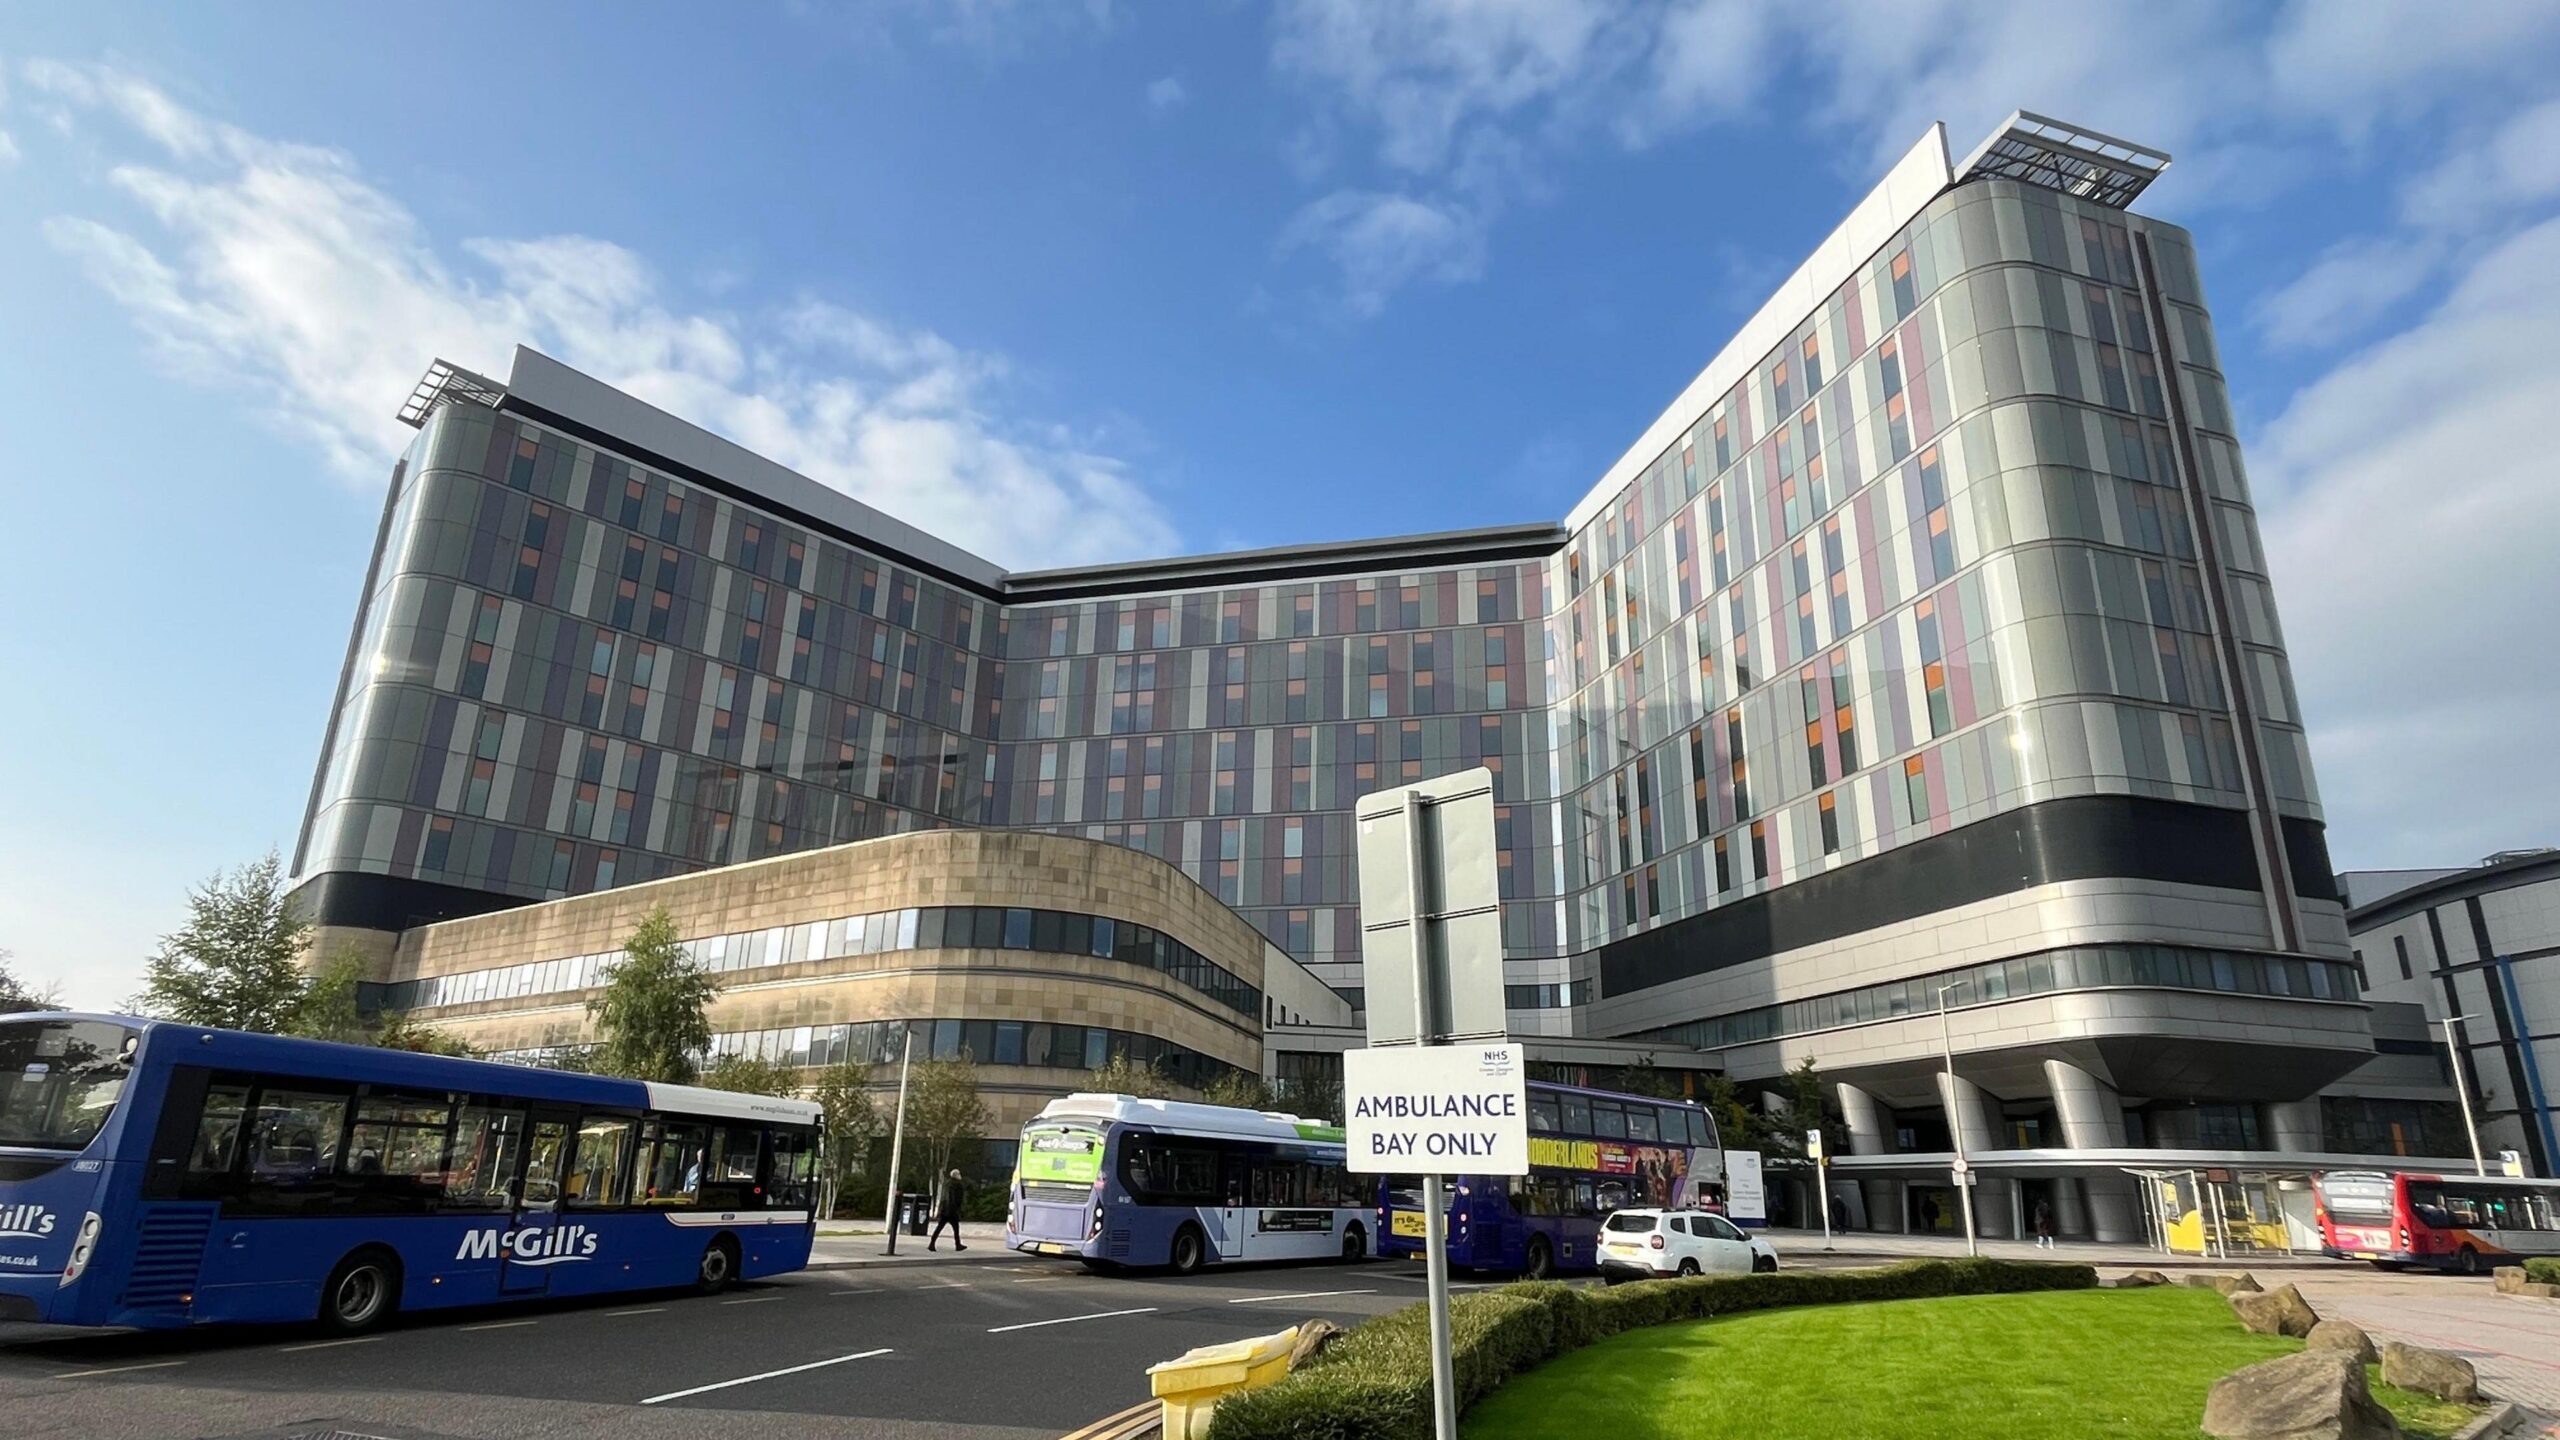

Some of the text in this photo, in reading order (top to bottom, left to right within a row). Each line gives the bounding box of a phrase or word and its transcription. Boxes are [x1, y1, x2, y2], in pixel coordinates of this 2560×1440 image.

[1484, 1050, 1508, 1061] NHS
[1355, 1094, 1516, 1118] AMBULANCE
[1372, 1133, 1418, 1155] BAY
[1426, 1133, 1497, 1155] ONLY
[1528, 1138, 1598, 1170] ORDERLANDS
[0, 1204, 56, 1233] ill's
[455, 1225, 598, 1260] McGill's
[0, 1255, 38, 1266] es.co.uk
